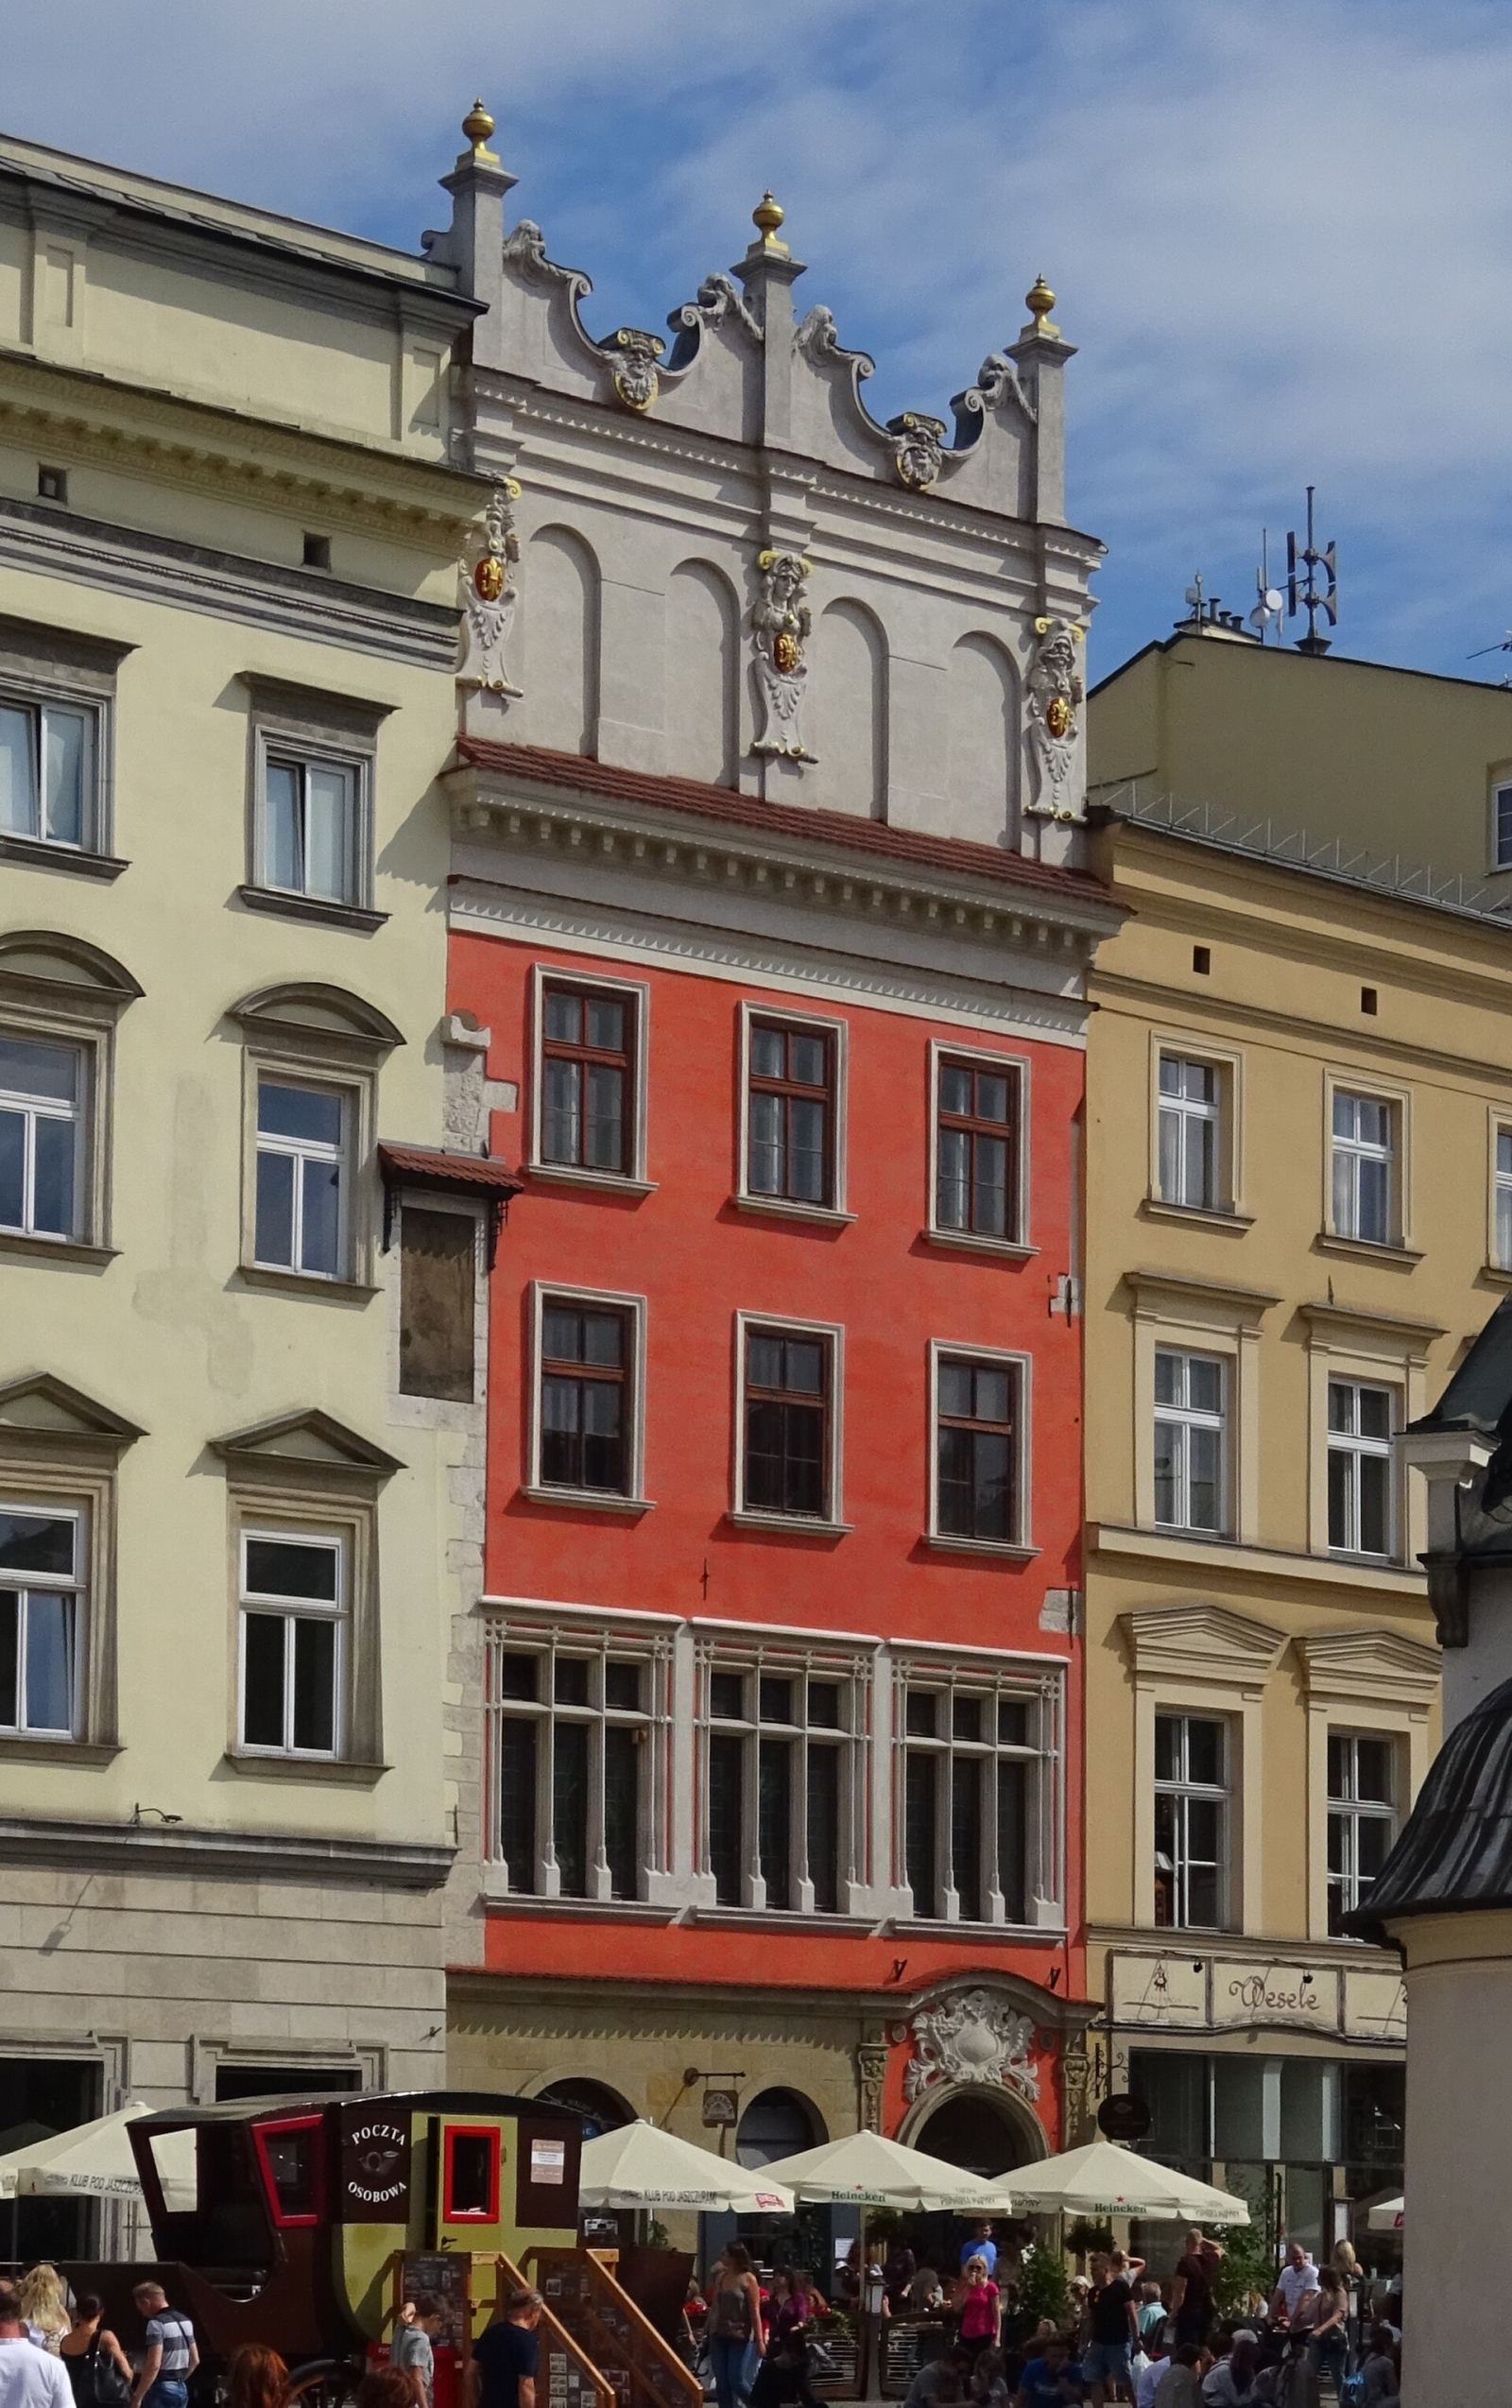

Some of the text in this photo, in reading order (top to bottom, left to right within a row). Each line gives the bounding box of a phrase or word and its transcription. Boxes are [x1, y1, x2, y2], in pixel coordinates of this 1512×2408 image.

[1228, 1975, 1321, 2011] Wesele
[352, 2124, 405, 2145] POCZTA
[71, 2174, 89, 2188] KLUB
[90, 2176, 104, 2190] POD
[348, 2181, 407, 2203] OSOBOWA
[644, 2189, 661, 2202] KLUB
[831, 2191, 885, 2203] Heineken
[1094, 2203, 1147, 2214] Heineken
